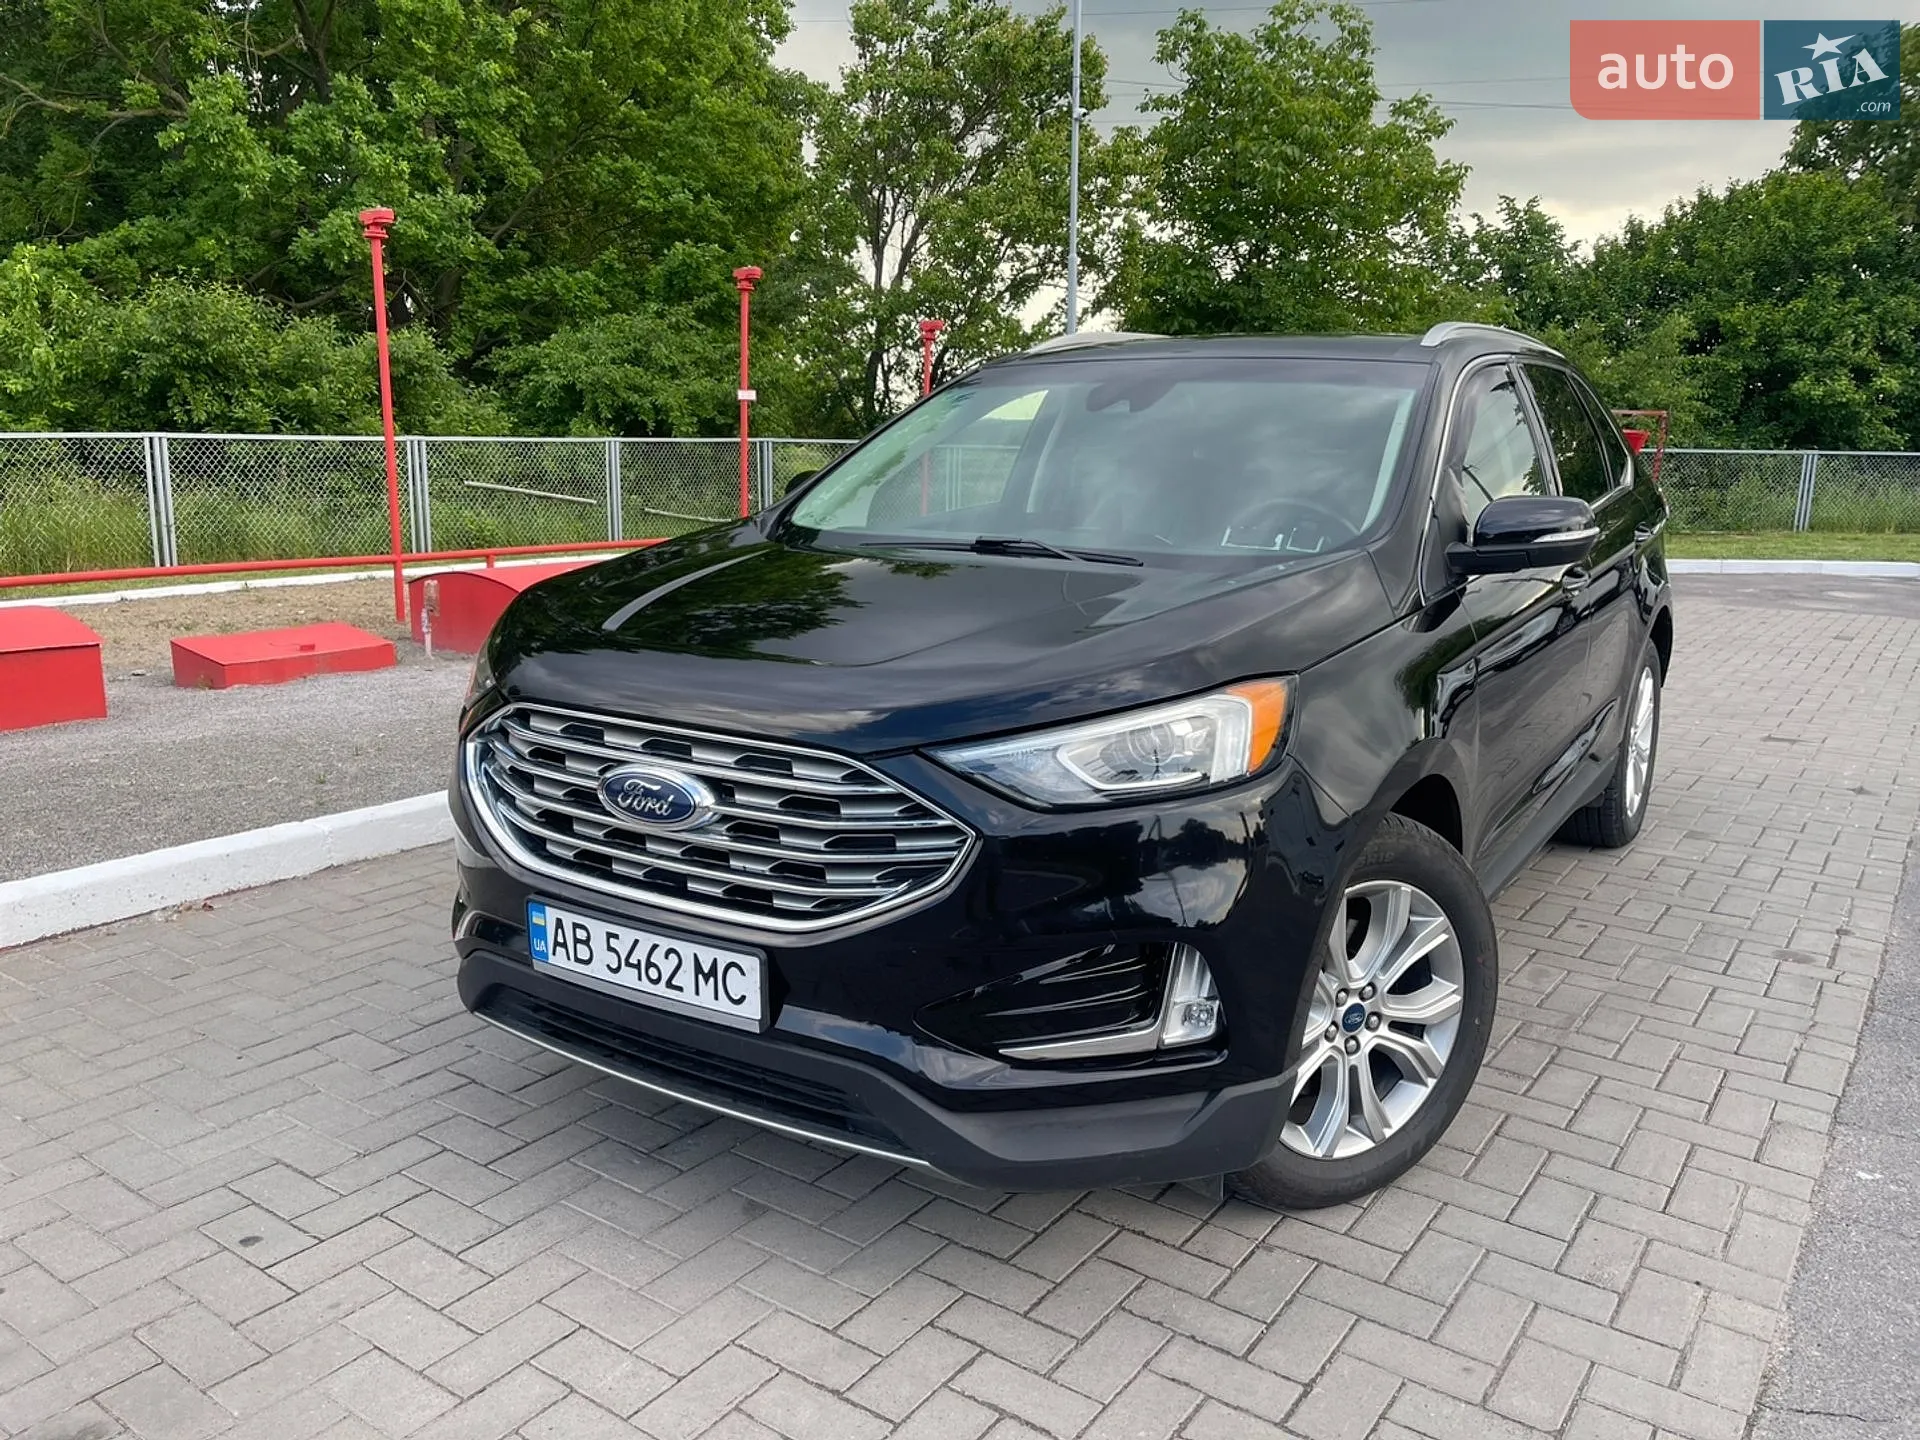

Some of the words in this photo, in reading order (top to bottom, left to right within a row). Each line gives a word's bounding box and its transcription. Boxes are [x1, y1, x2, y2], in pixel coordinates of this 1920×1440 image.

[618, 779, 674, 816] Ford
[533, 937, 547, 953] UA
[552, 917, 594, 966] AB
[605, 931, 684, 992] 5462
[693, 952, 747, 1006] MC
